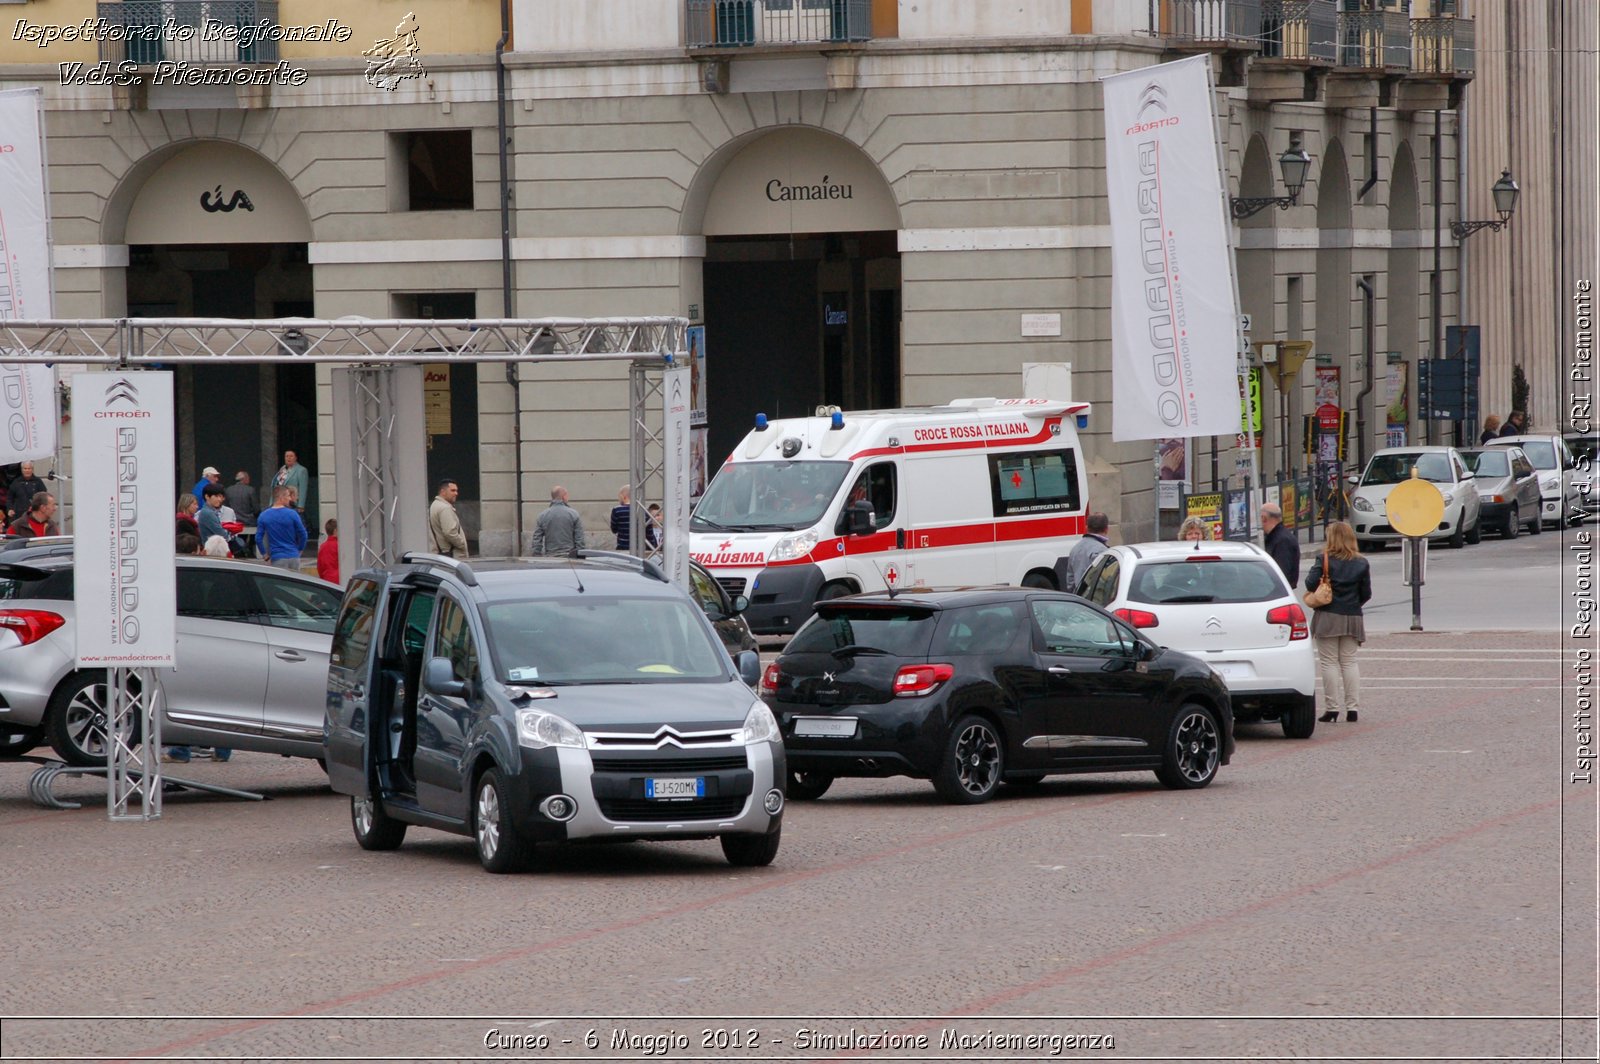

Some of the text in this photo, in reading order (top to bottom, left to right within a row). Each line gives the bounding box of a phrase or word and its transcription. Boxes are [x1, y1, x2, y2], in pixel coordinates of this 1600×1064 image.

[914, 422, 1029, 441] CROCE ROSSA ITALIANA
[118, 427, 140, 644] ARMANDO
[81, 654, 171, 662] www.armandocitroen.it
